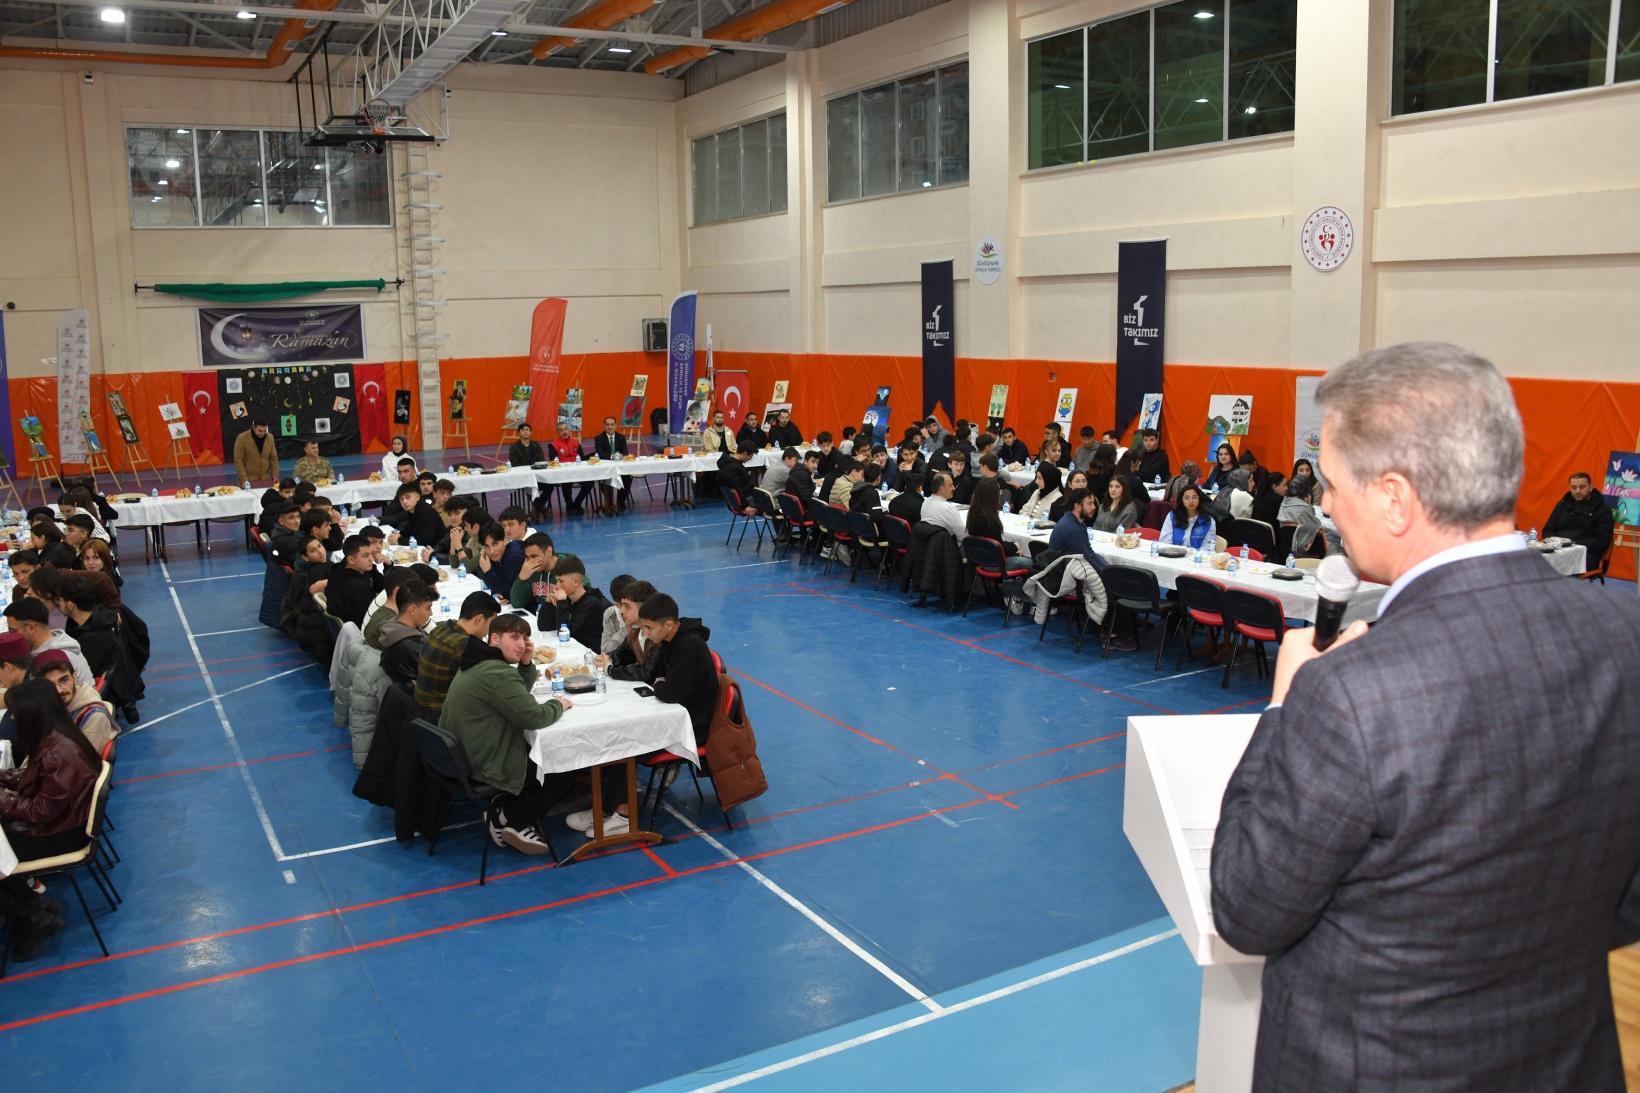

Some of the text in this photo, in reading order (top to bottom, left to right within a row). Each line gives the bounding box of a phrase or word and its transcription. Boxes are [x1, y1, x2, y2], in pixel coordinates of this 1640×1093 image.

[1123, 313, 1136, 324] BİZ
[926, 320, 935, 330] BİZ
[269, 331, 356, 348] Ramazan
